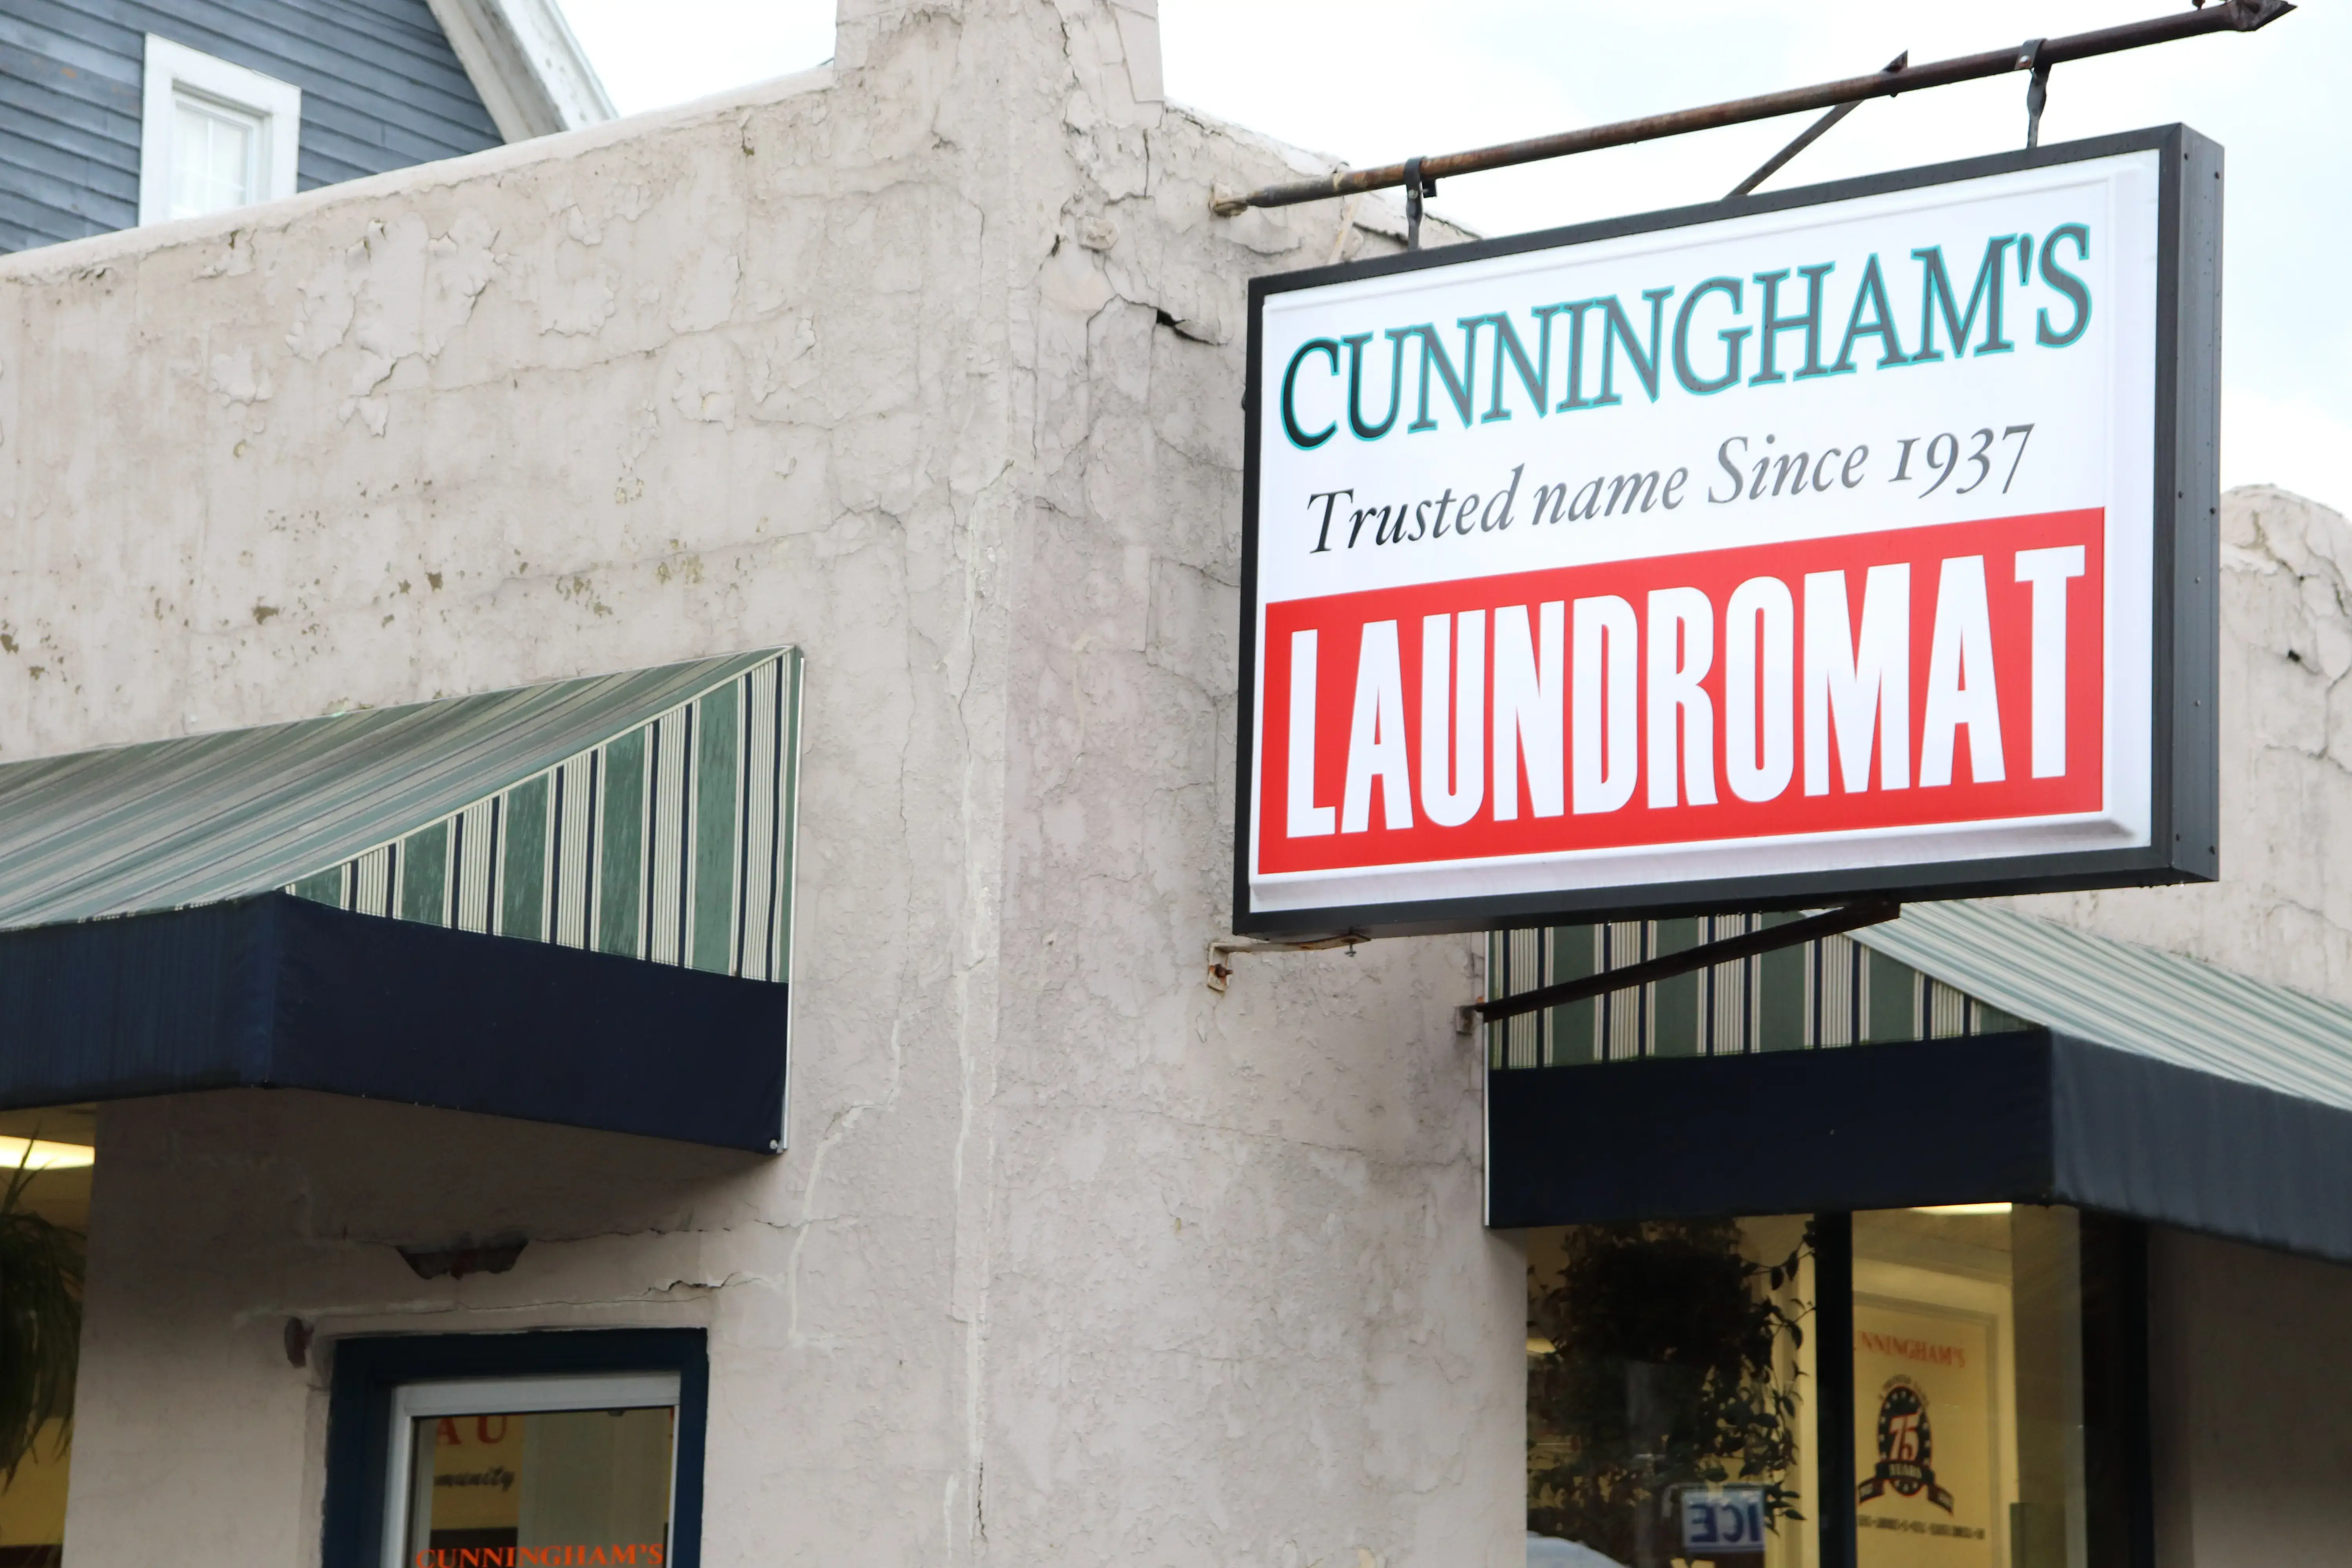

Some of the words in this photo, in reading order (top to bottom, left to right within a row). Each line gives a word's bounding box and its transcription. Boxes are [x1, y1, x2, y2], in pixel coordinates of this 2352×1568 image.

[1280, 222, 2093, 452] CUNNINGHAM'S
[1308, 463, 1526, 555] Trusted
[1531, 467, 1688, 524] name
[1706, 433, 1870, 505] Since
[1887, 423, 2034, 499] 1937
[1285, 544, 2086, 839] LAUNDROMAT
[1889, 1407, 1922, 1461] 75
[416, 1544, 664, 1568] CUNNINGHAM'S
